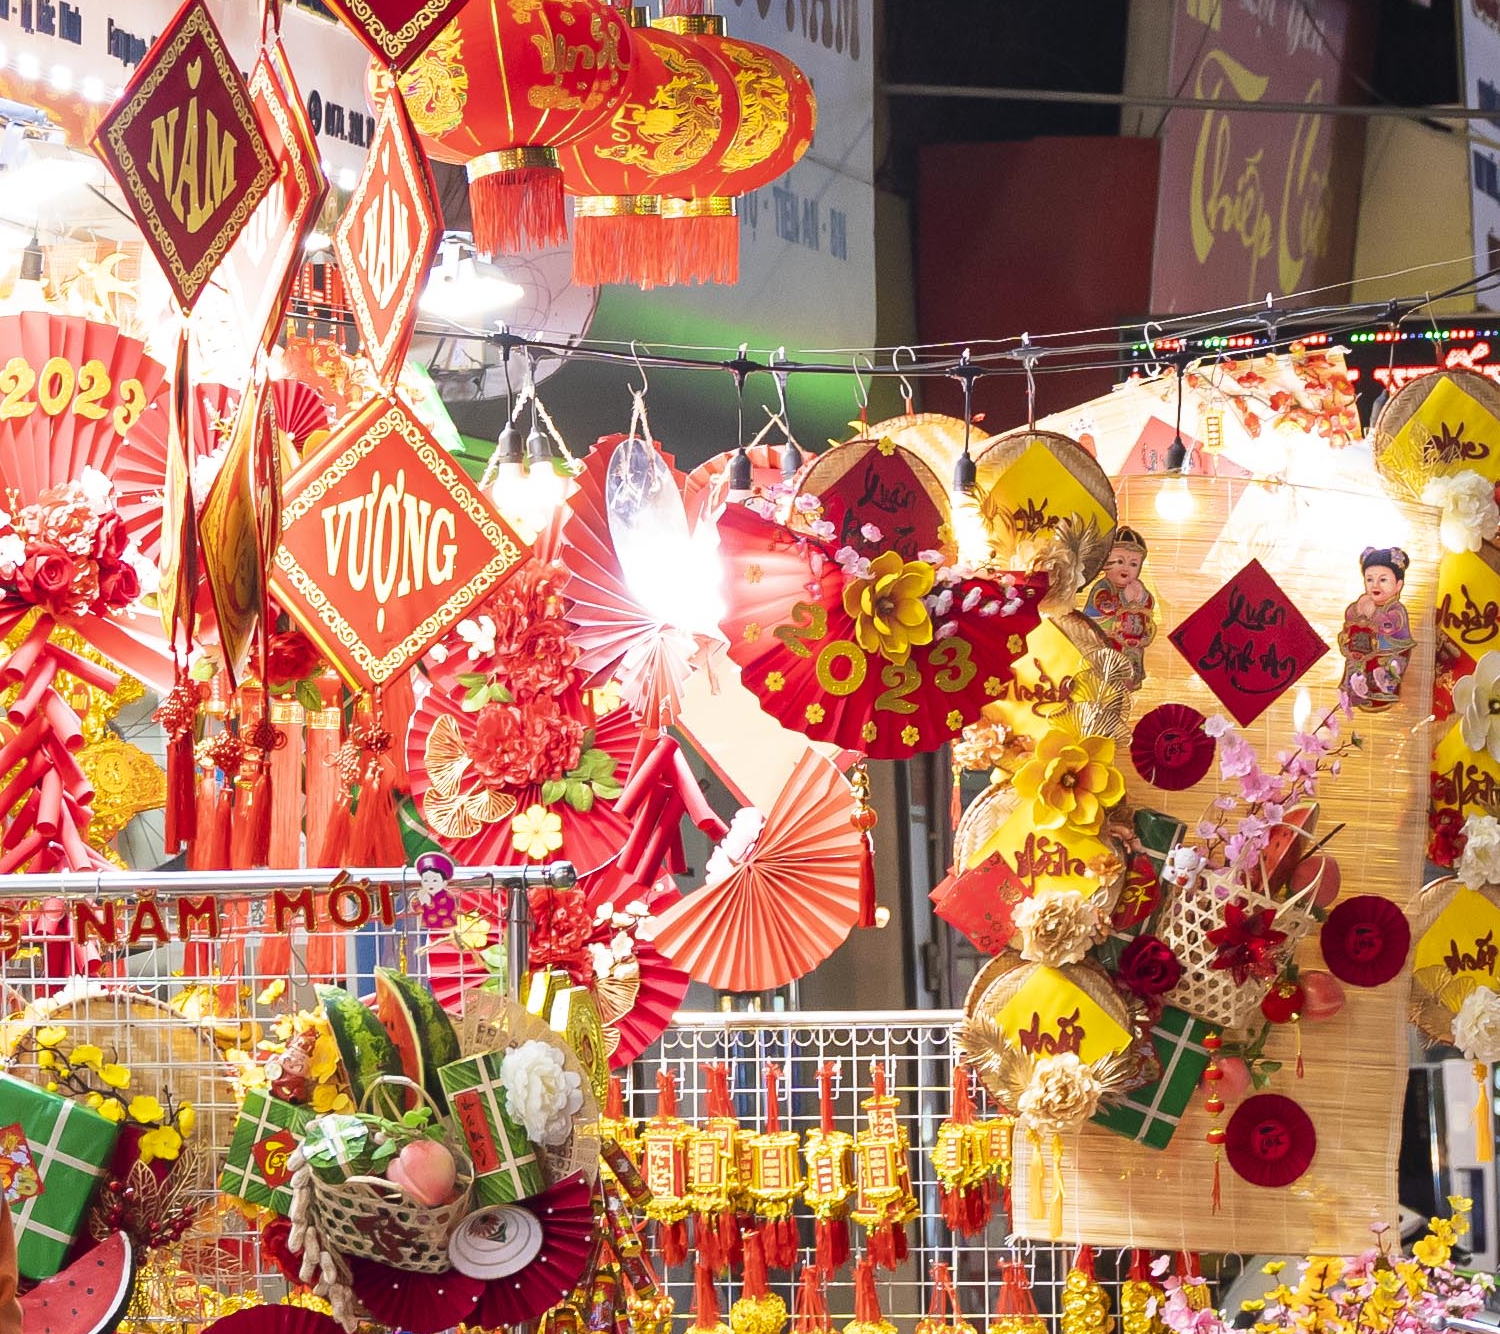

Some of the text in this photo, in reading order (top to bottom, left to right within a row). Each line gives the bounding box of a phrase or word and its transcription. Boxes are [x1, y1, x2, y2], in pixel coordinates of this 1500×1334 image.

[321, 467, 458, 635] VƯỢNG
[772, 601, 978, 715] 2023
[77, 887, 221, 947] NĂM
[274, 869, 396, 932] MỚI
